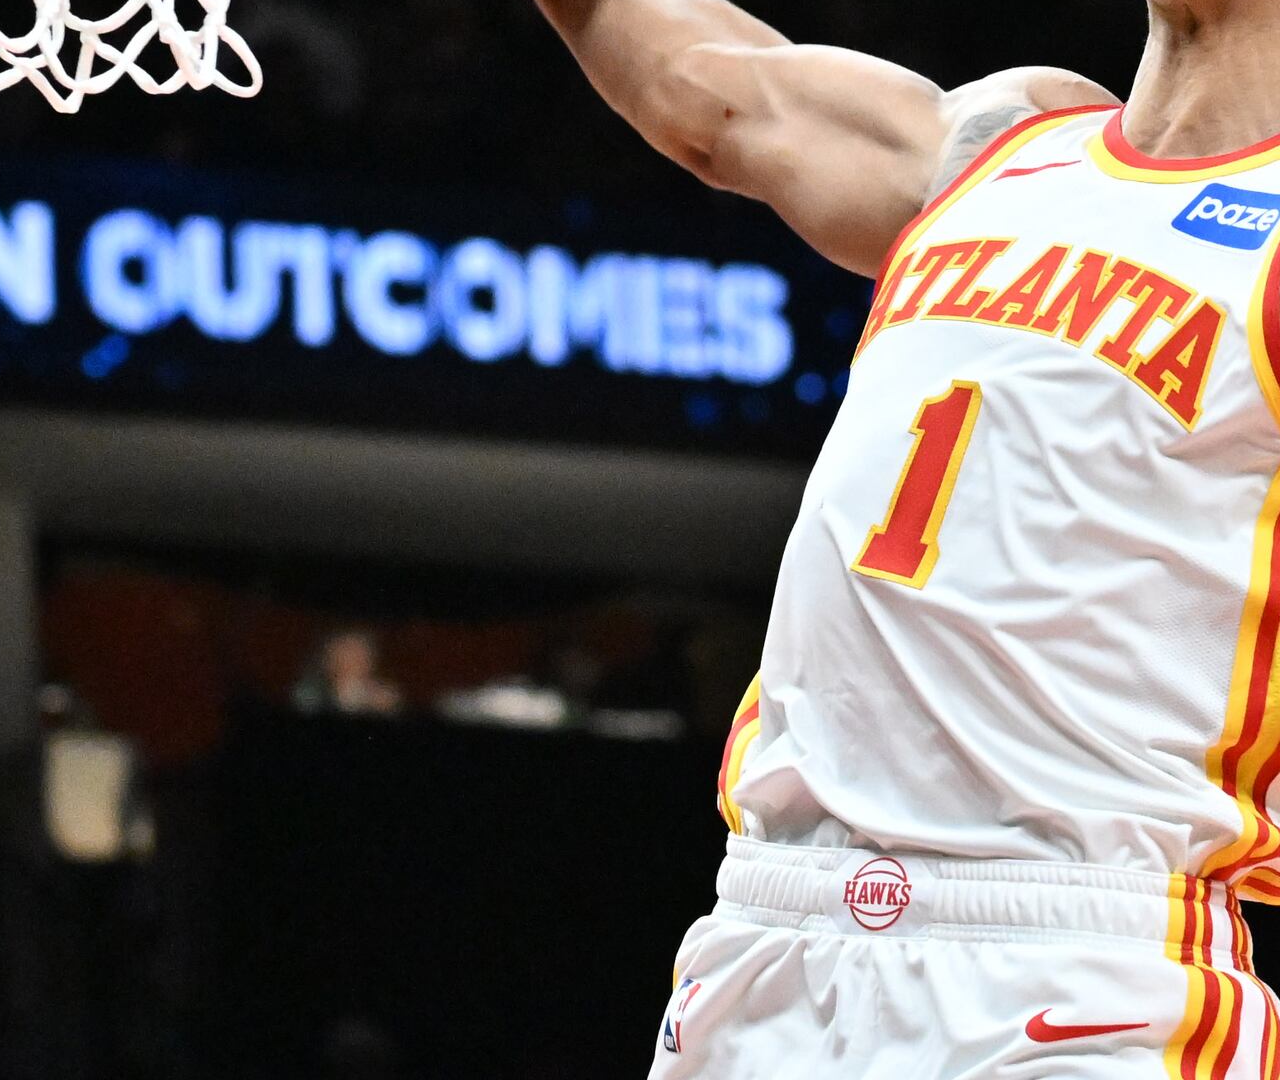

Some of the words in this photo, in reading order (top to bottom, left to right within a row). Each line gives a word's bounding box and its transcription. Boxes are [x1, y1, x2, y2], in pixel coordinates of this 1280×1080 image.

[83, 210, 793, 385] OUTCOMES
[1186, 195, 1280, 232] paze
[852, 237, 1227, 432] ATLANTA
[850, 378, 983, 589] 1
[842, 880, 913, 907] HAWKS
